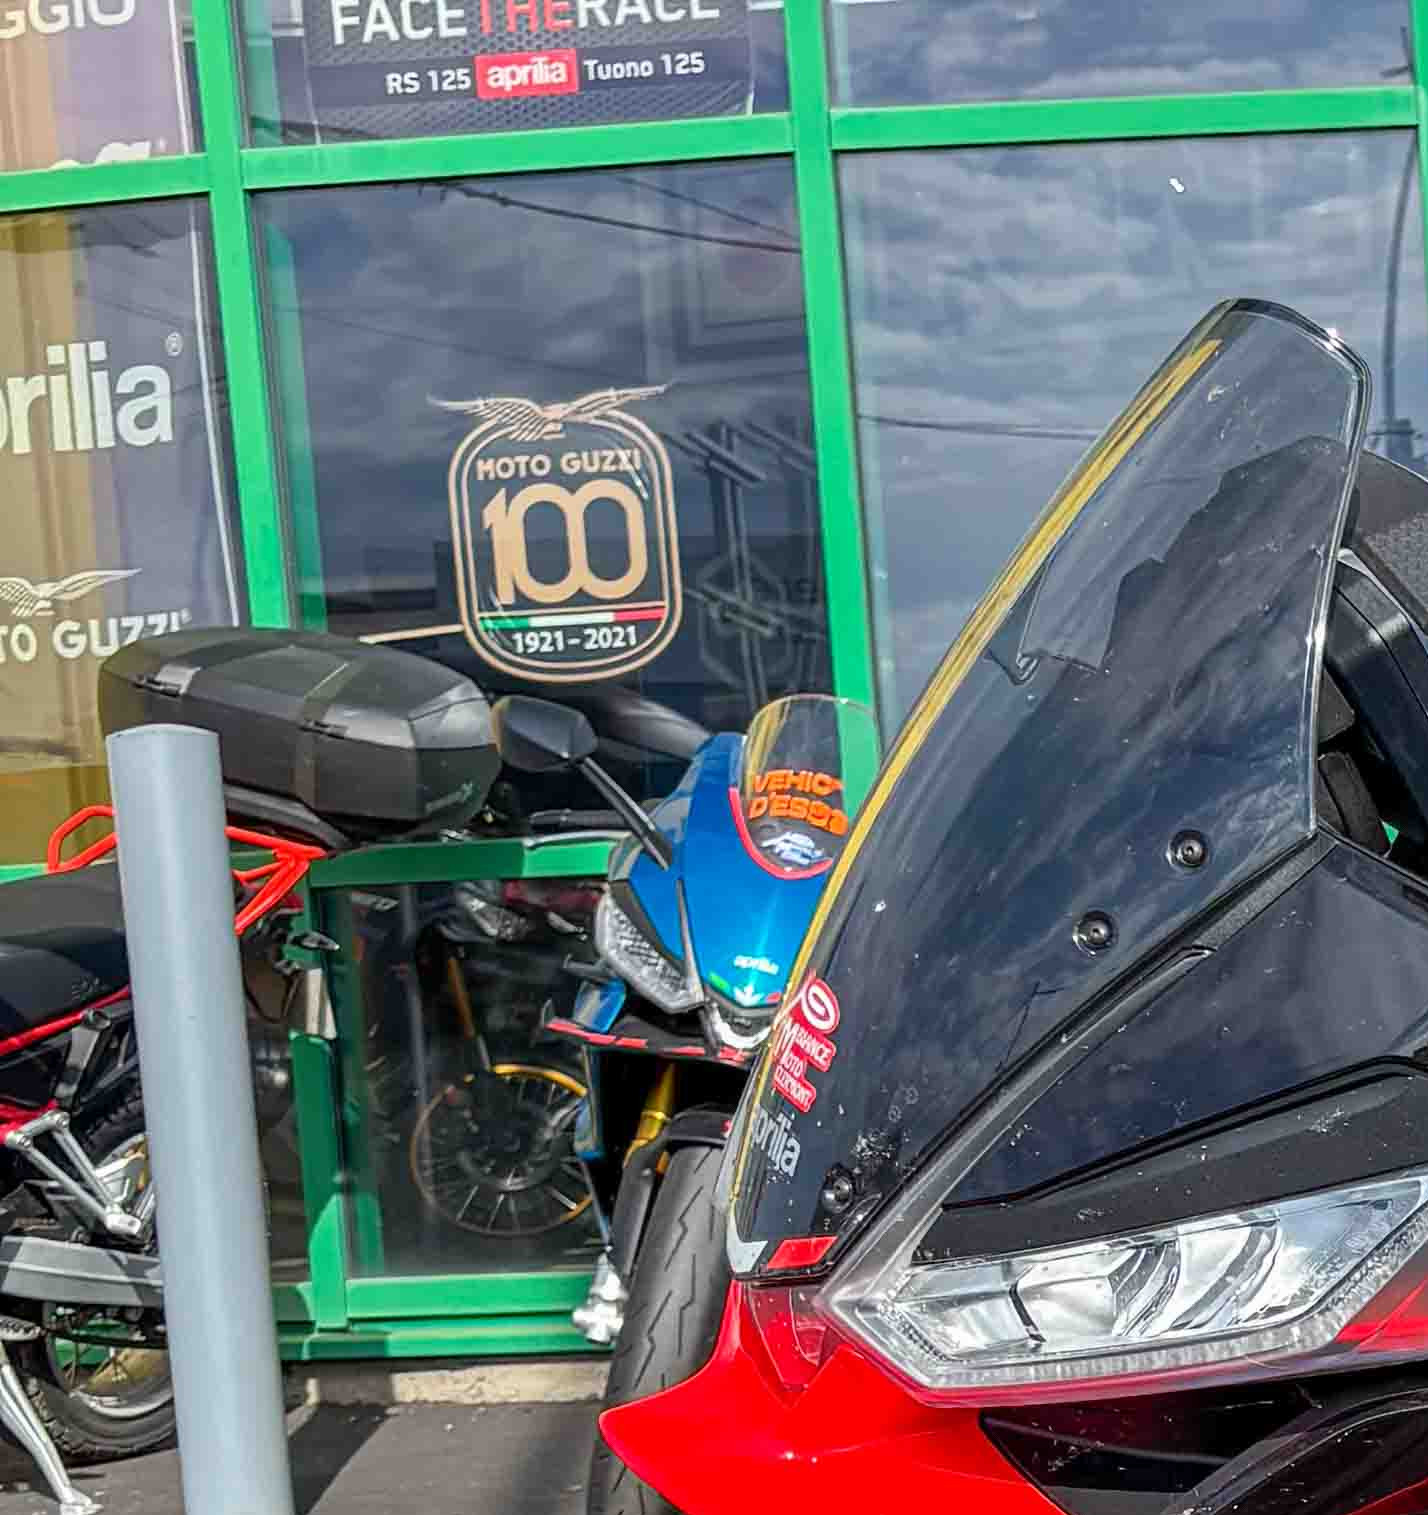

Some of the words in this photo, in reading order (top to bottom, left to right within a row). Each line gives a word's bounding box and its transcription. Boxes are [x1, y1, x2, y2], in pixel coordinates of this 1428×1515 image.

[385, 72, 420, 95] RS
[427, 67, 472, 92] 125
[486, 56, 569, 91] aprilia
[583, 57, 655, 82] Tuono
[660, 51, 706, 76] 125
[477, 454, 552, 481] MOTO
[560, 449, 642, 475] GUZZI
[482, 479, 649, 606] 100
